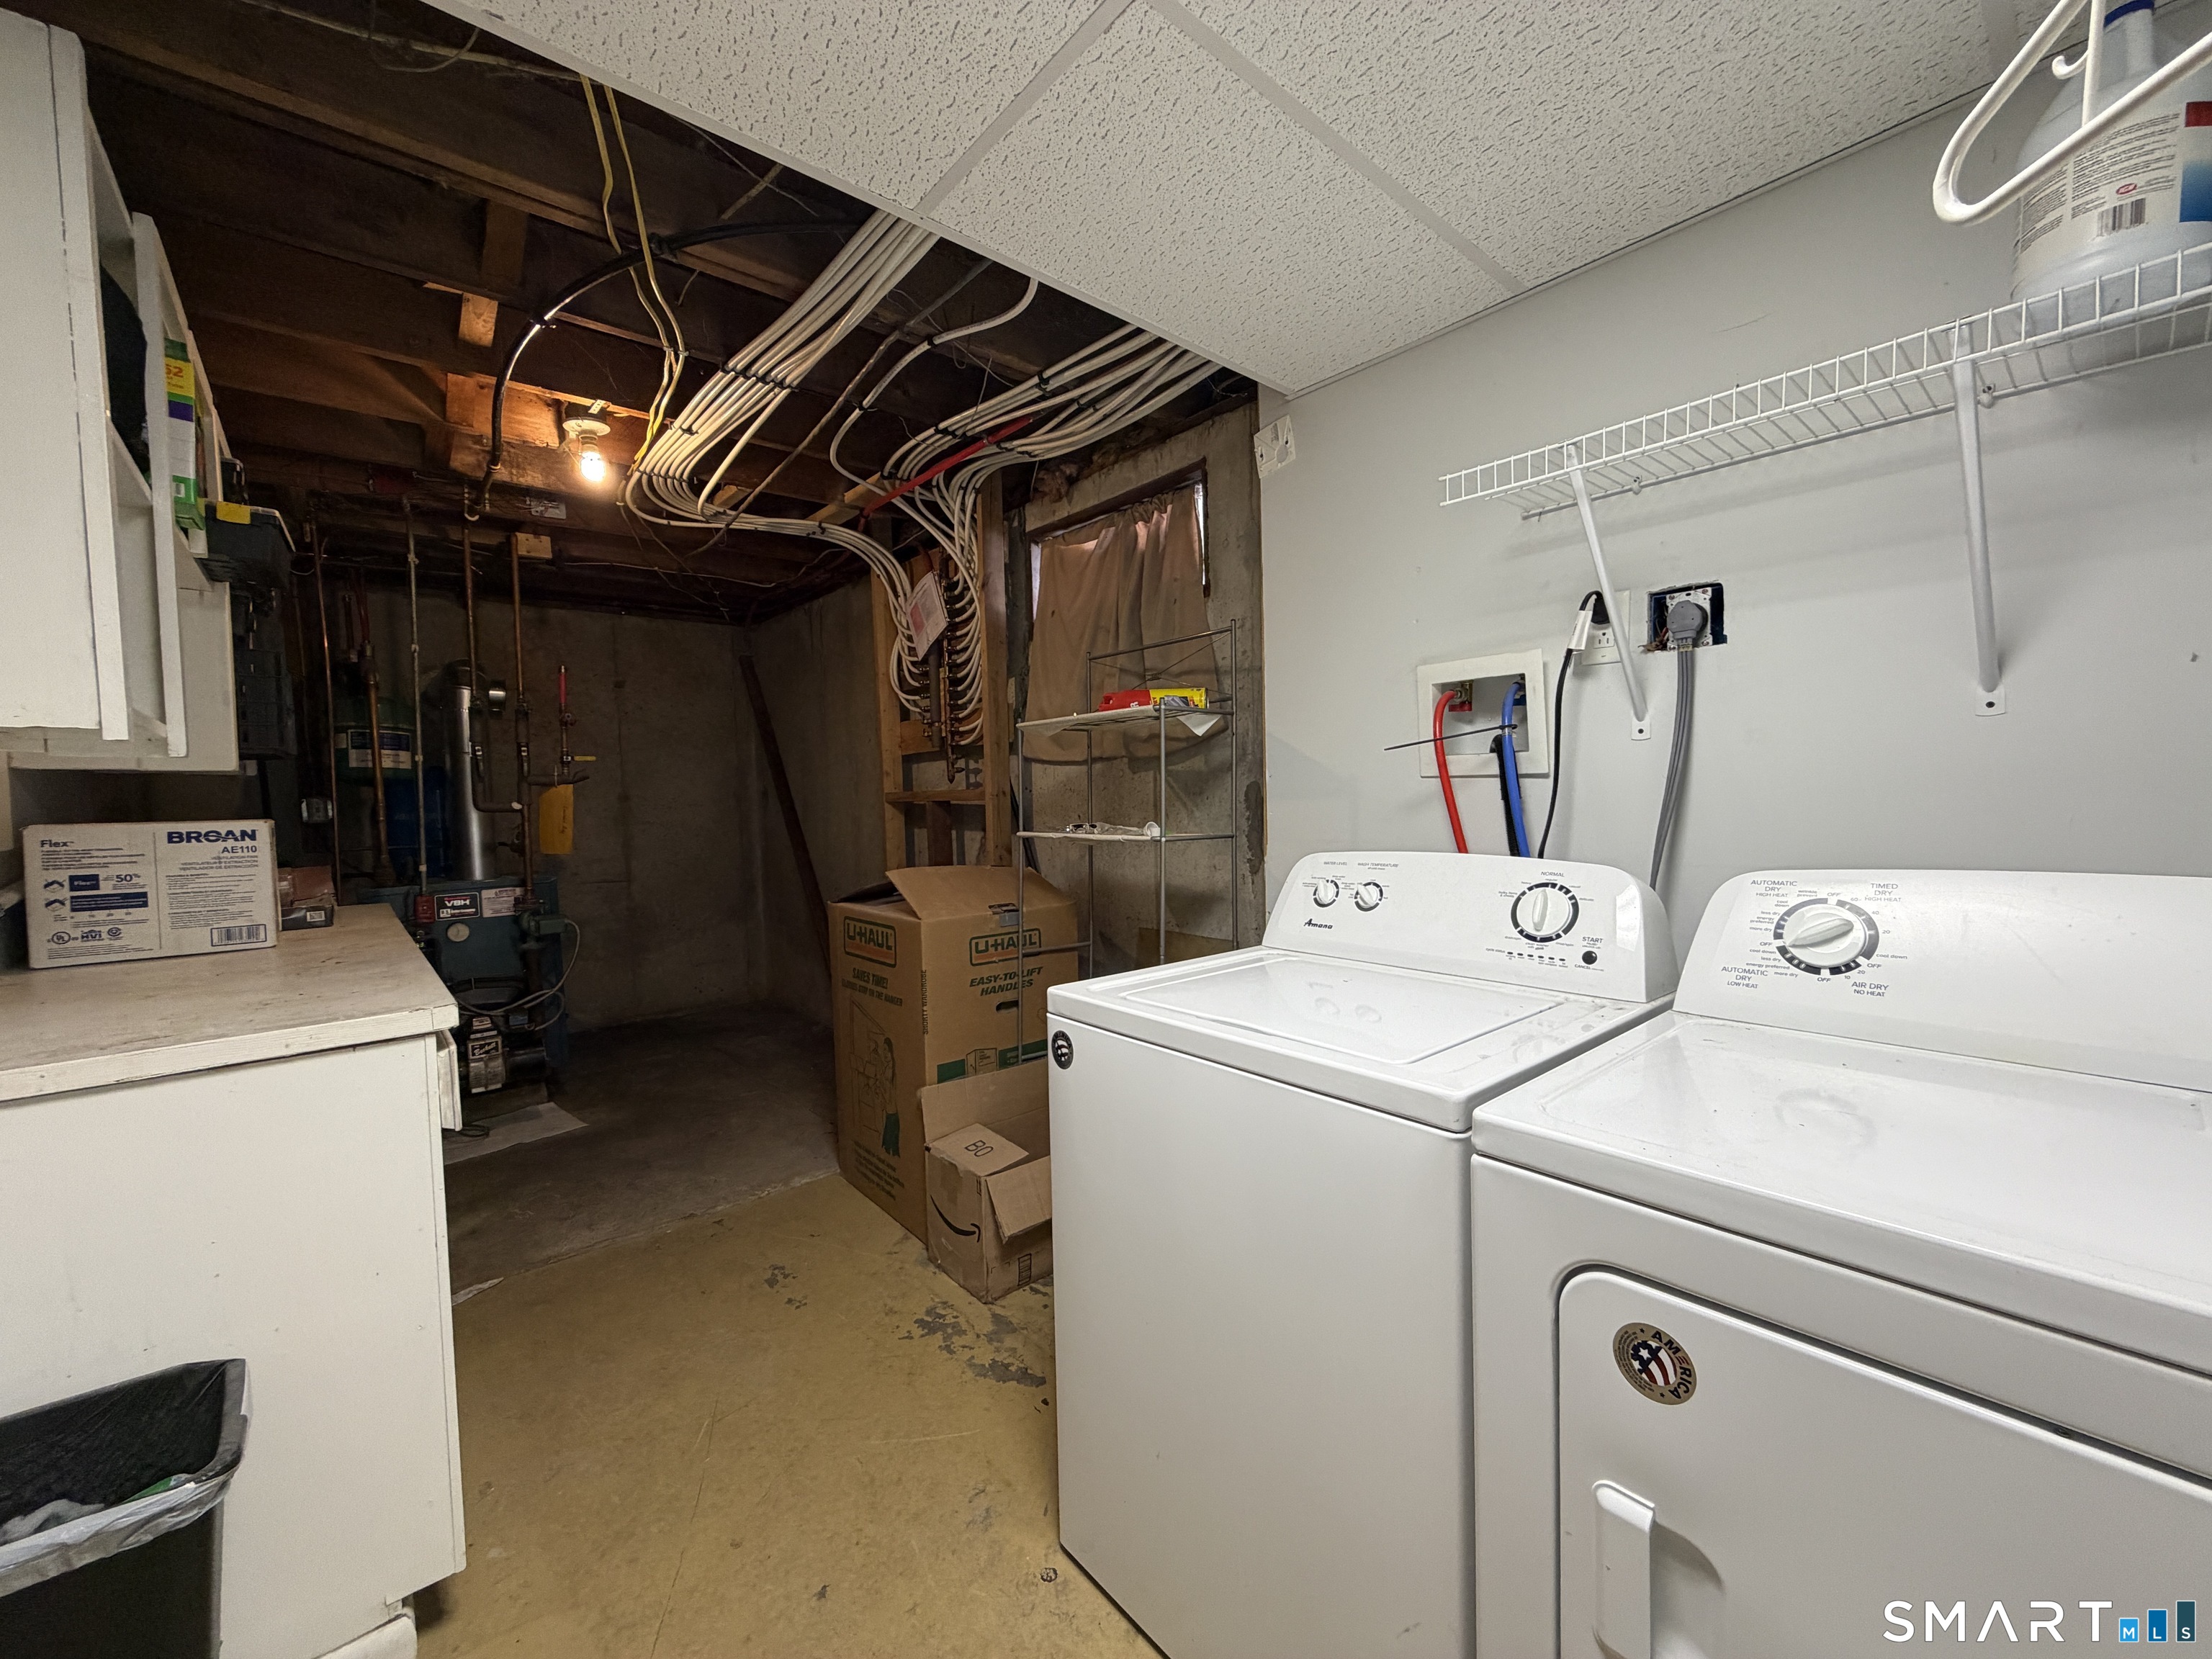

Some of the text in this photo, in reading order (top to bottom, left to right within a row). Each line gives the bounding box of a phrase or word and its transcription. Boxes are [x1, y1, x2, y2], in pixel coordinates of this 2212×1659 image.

[40, 840, 69, 848] Flex
[166, 829, 257, 844] BROAN
[221, 845, 257, 854] AE110
[1303, 918, 1333, 930] Amana
[846, 922, 893, 950] U-HAUL
[974, 932, 1038, 954] U-HAUL
[853, 967, 871, 984] SAVES
[969, 966, 1043, 987] EASY-TO-LIFT
[1721, 966, 1768, 976] AUTOMATIC
[980, 979, 1034, 997] HANDLES
[1650, 1330, 1692, 1399] AMERICA
